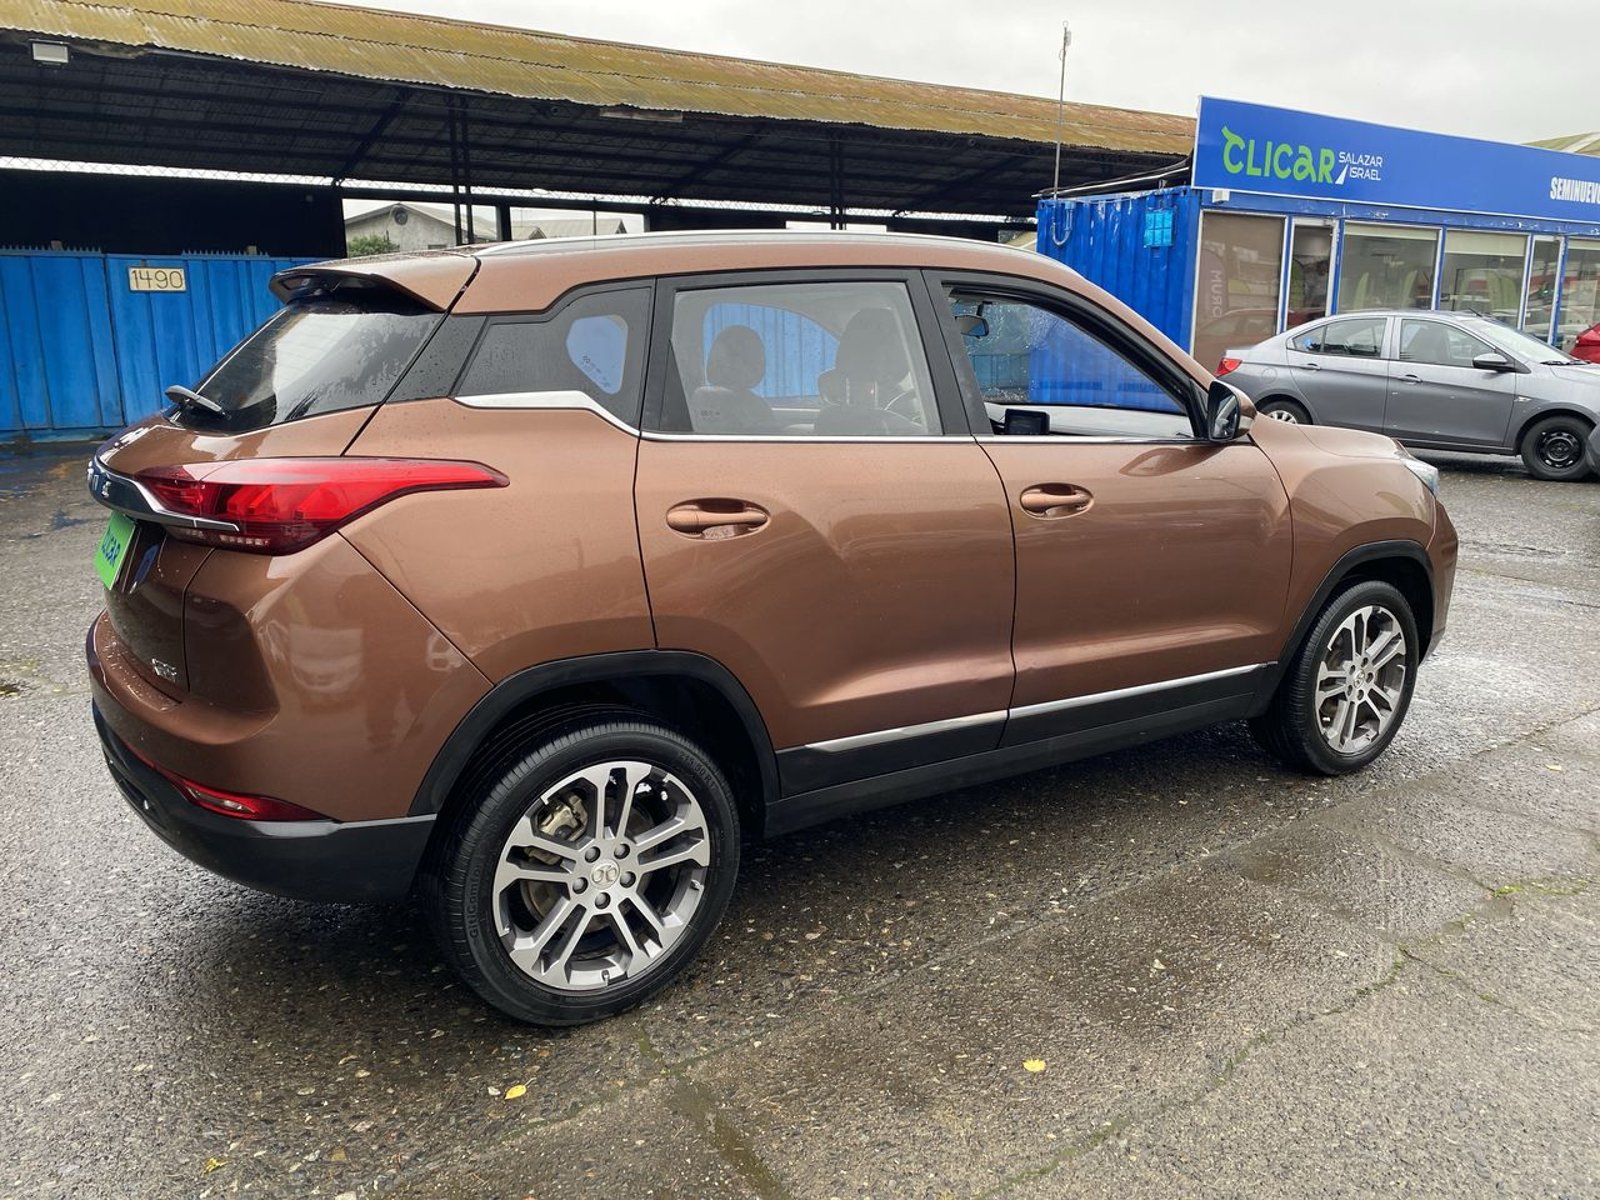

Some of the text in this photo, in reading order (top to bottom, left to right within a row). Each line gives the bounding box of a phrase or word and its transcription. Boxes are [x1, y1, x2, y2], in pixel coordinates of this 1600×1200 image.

[1338, 151, 1383, 168] SALAZAR
[1349, 167, 1381, 181] ISRAEL
[131, 269, 184, 290] 1490
